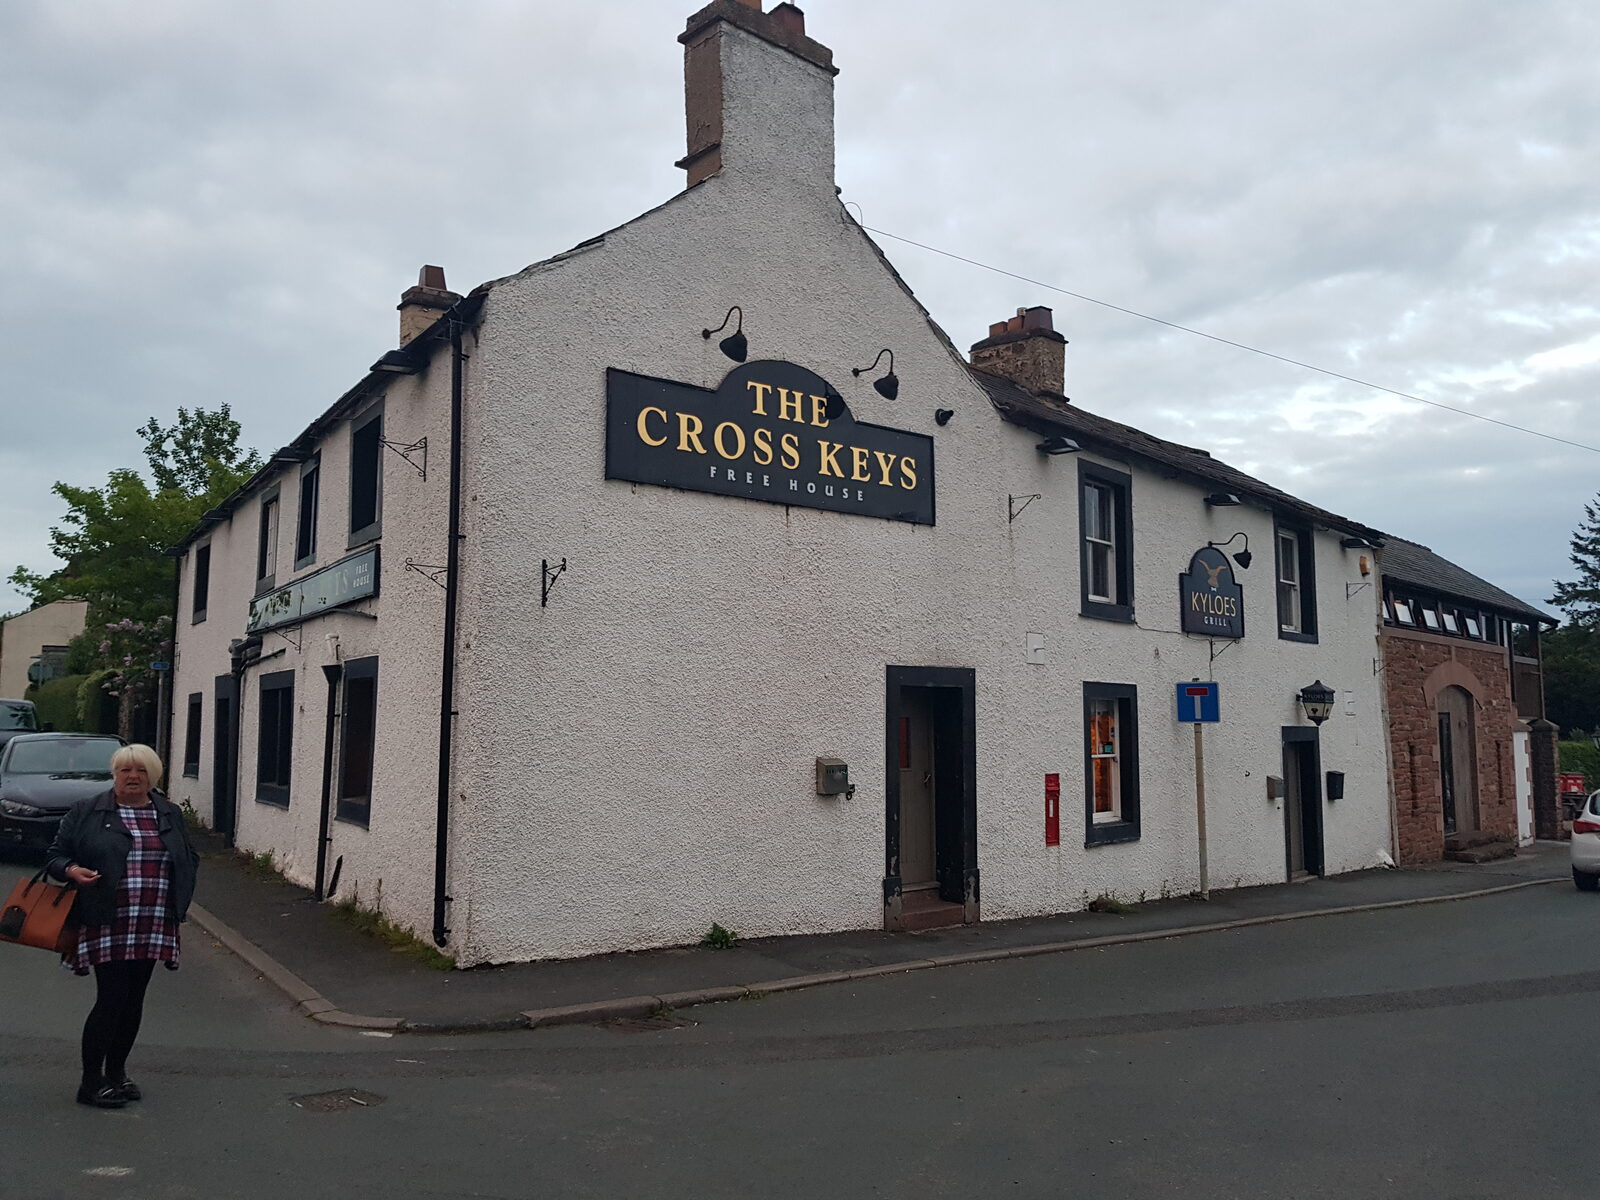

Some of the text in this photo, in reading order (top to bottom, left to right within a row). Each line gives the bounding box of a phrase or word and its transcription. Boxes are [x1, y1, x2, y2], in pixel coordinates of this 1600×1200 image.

[746, 380, 830, 428] THE
[636, 406, 917, 491] CROSS KEYS
[709, 465, 864, 502] FREE HOUSE
[1191, 591, 1237, 617] KYLOES
[1204, 616, 1227, 626] GRILL
